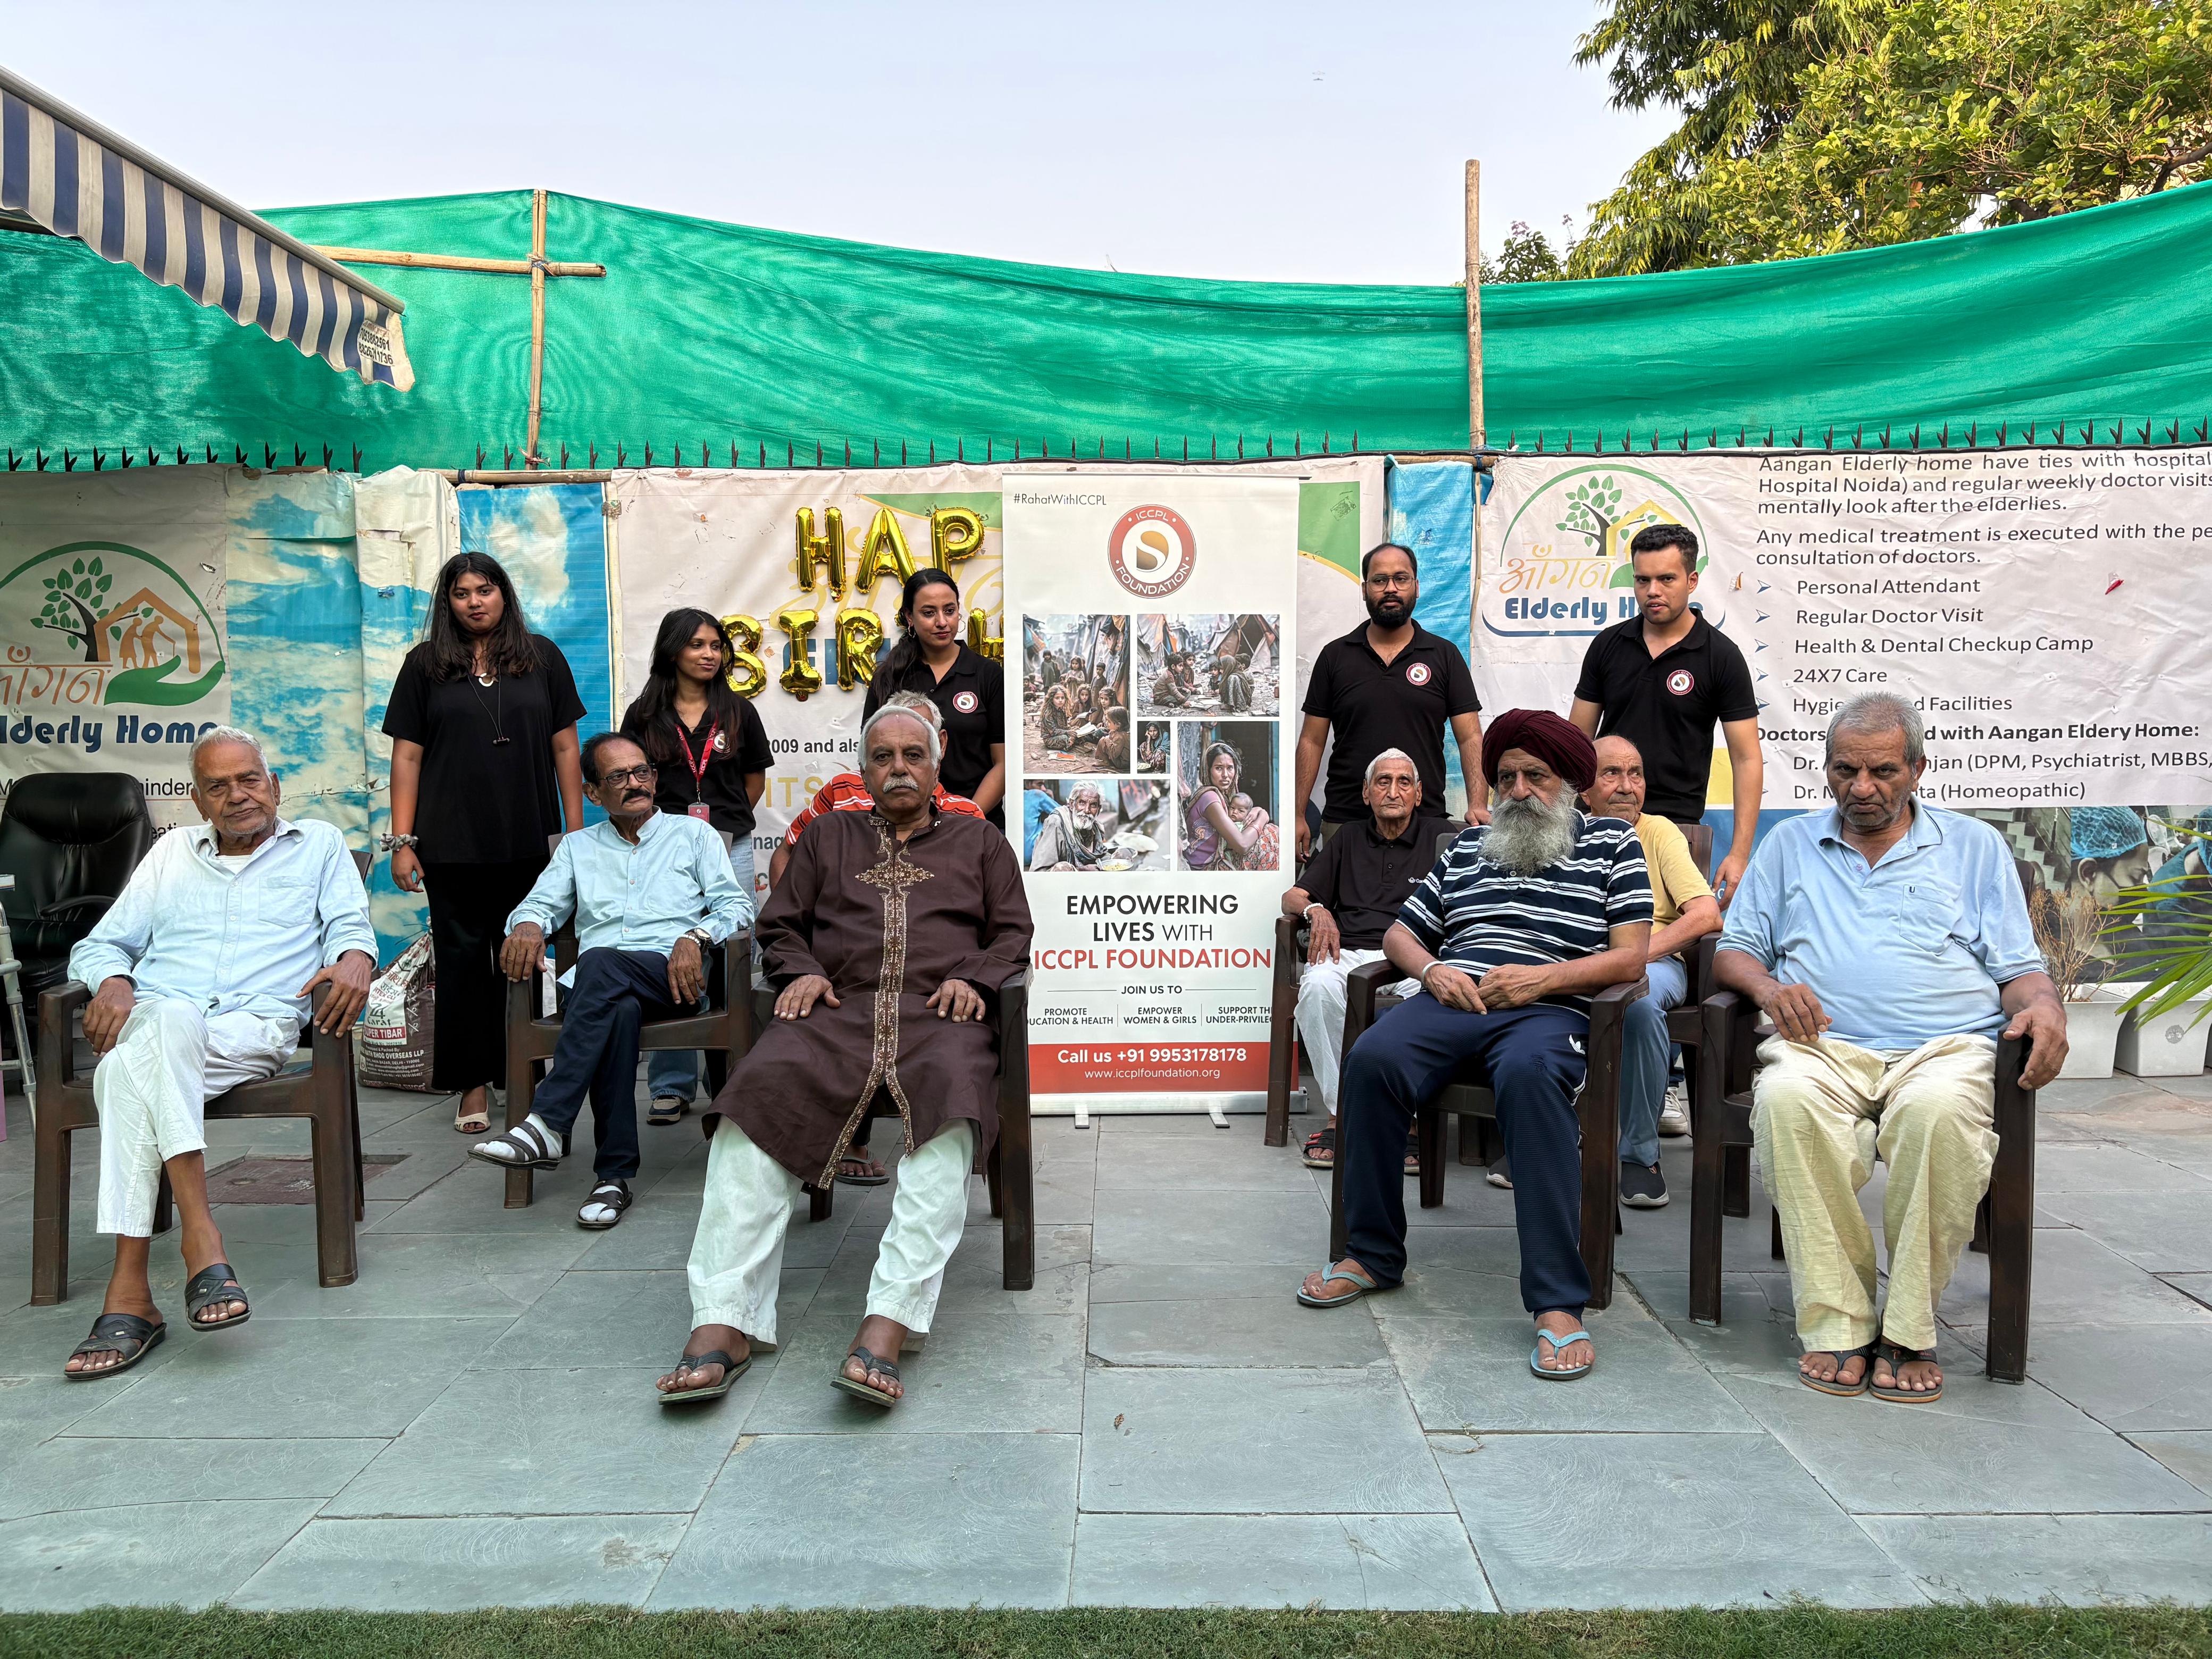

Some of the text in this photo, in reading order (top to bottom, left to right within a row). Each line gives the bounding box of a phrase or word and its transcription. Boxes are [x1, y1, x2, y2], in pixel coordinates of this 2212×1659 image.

[1759, 451, 2211, 474] Aangan Elderly home have ties with hospital
[1759, 472, 2212, 496] Hospital Noida) and regular weekly doctor visits
[1013, 493, 1107, 506] #RahatWithICCPL
[1758, 496, 2067, 517] mentally look after the elderlies.
[1135, 509, 1169, 522] ICCPL
[1756, 530, 1792, 547] Any
[1798, 528, 1874, 543] medical
[1880, 527, 1981, 543] treatment
[1987, 527, 2001, 541] is
[2007, 524, 2099, 541] executed
[2105, 523, 2146, 539] with
[2152, 523, 2185, 538] the
[1756, 549, 1981, 565] consultation of doctors.
[1116, 563, 1191, 595] FOUNDATION
[1797, 578, 1981, 594] Personal Attendant
[1504, 596, 1608, 626] Elderly
[1796, 608, 1984, 627] Regular Doctor Visit
[1795, 636, 2094, 654] Health & Dental Checkup Camp
[1792, 668, 1888, 683] 24X7 Care
[1929, 696, 2013, 711] Facilities
[0, 715, 103, 753] lderly
[1940, 725, 1983, 740] with
[1988, 725, 2063, 742] Aangan
[2067, 723, 2132, 741] Eldery
[2134, 723, 2200, 738] Home:
[803, 738, 834, 753] and
[1793, 756, 1819, 771] Dr.
[1967, 754, 2026, 772] (DPM,
[2032, 752, 2146, 771] Psychiatrist,
[2151, 751, 2212, 769] MBBS,
[142, 777, 192, 797] inder
[1794, 785, 1817, 799] Dr.
[1940, 782, 2085, 801] (Homeopathic)
[1066, 894, 1239, 915] EMPOWERING
[1093, 921, 1212, 942] LIVES WITH
[1034, 948, 1271, 970] ICCPL FOUNDATION
[1121, 985, 1183, 994] JOIN US TO
[1044, 1008, 1088, 1016] PROMOTE
[1218, 1006, 1258, 1015] SUPPORT
[1027, 1017, 1069, 1026] UCATION
[1172, 1016, 1197, 1024] GIRLS
[379, 1028, 403, 1038] TIBAR
[386, 1051, 413, 1060] OVERSEAS
[413, 1049, 424, 1058] LLP
[1057, 1048, 1247, 1063] Call us +91 9953178178
[1084, 1067, 1220, 1079] www.iccplfoundation.org
